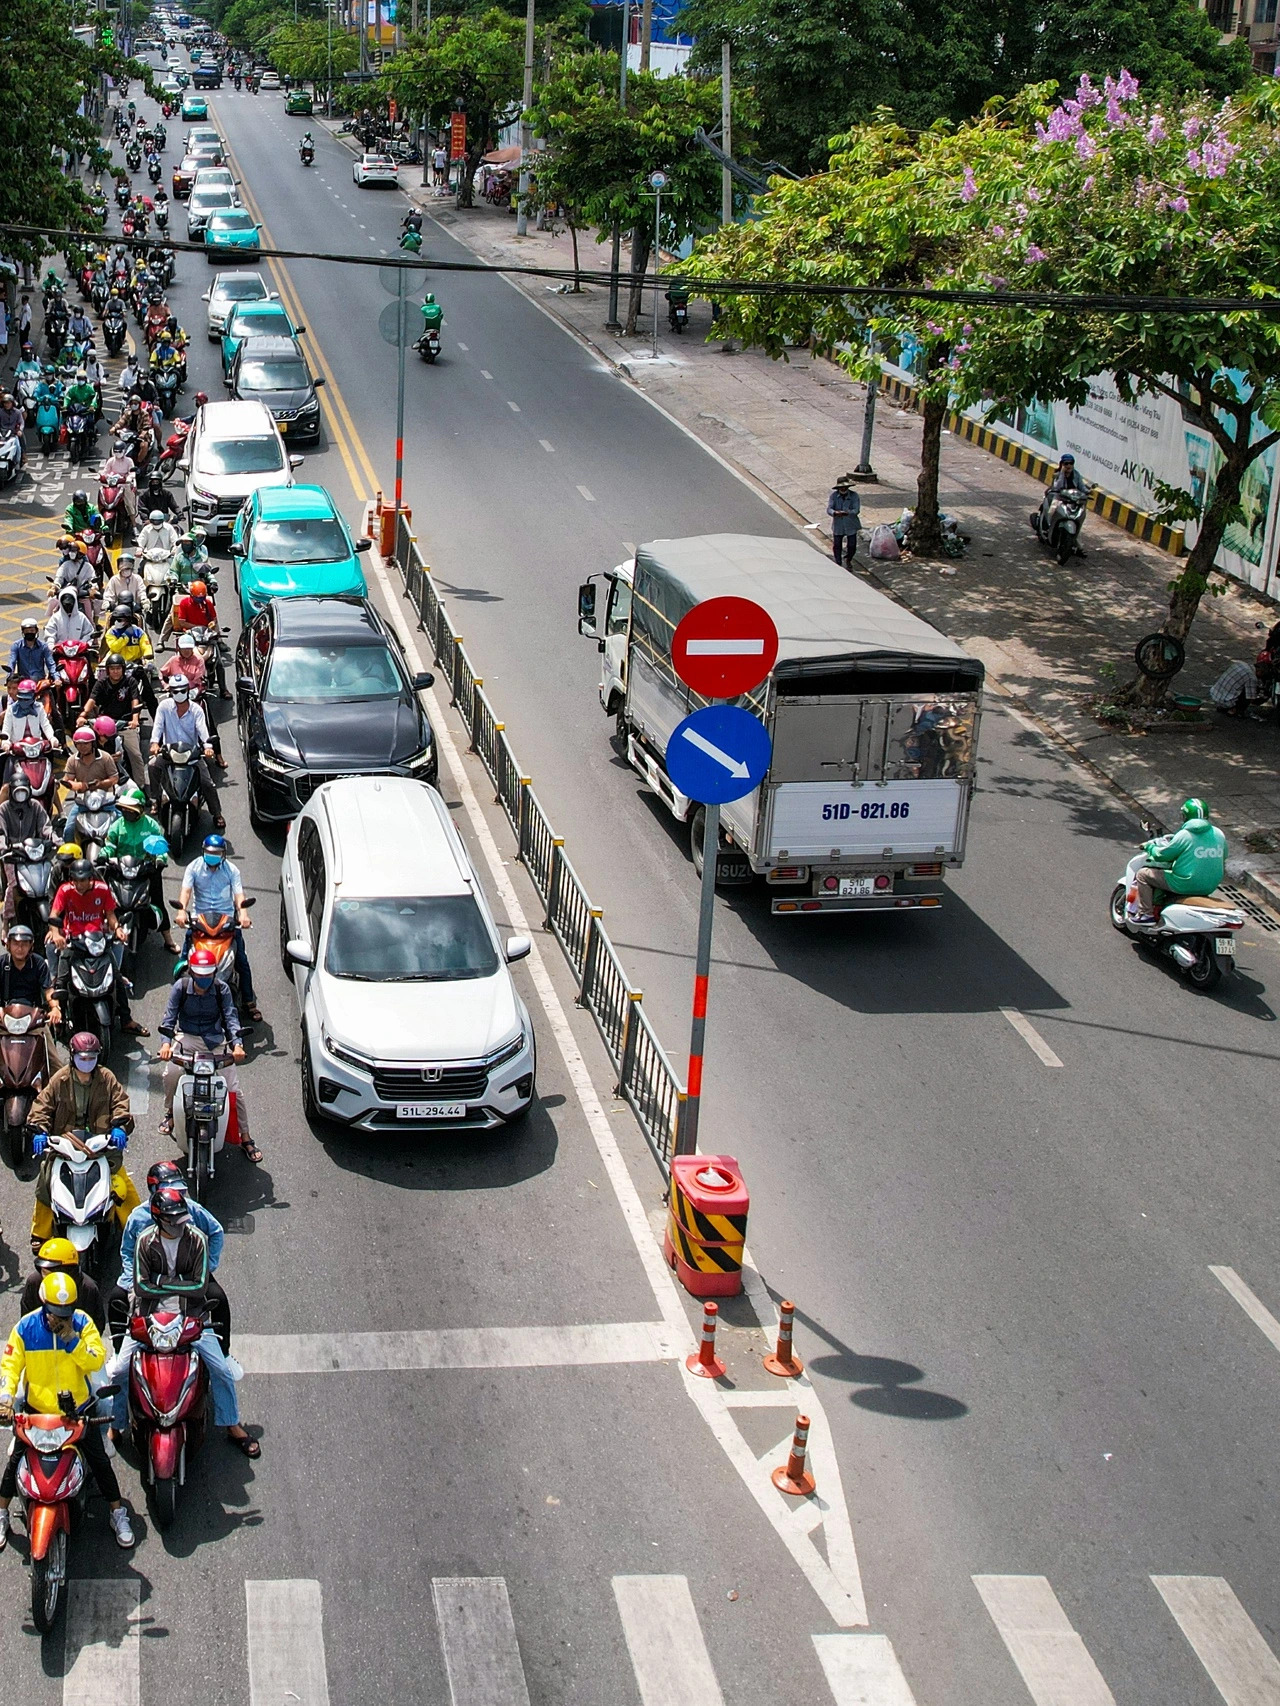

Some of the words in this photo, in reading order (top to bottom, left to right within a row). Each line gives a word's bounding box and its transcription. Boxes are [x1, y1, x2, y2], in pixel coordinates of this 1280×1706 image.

[822, 802, 910, 820] 51D-821.86
[1194, 846, 1224, 858] Grab
[402, 1107, 460, 1116] 51L-294.44
